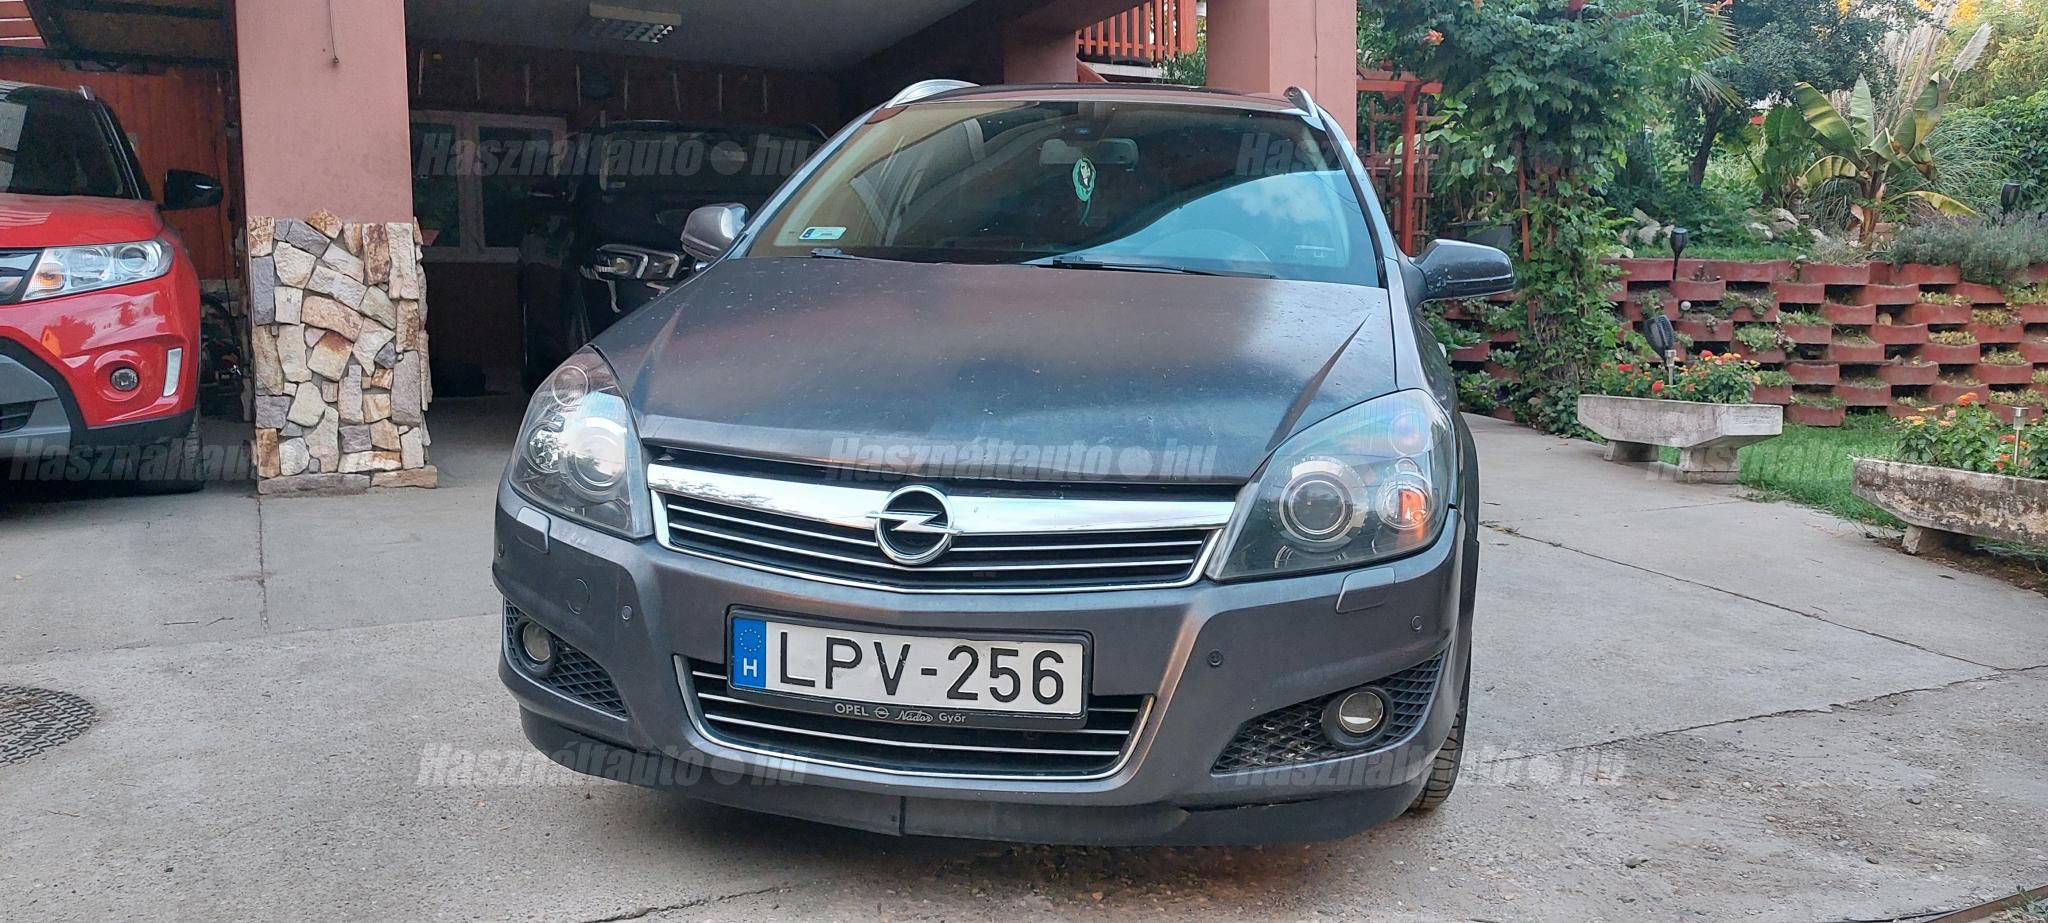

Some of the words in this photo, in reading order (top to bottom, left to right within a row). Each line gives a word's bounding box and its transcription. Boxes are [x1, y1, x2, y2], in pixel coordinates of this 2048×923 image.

[743, 657, 758, 678] H
[780, 631, 1064, 705] LPV-256
[834, 702, 869, 717] OPEL
[938, 712, 967, 724] Győr
